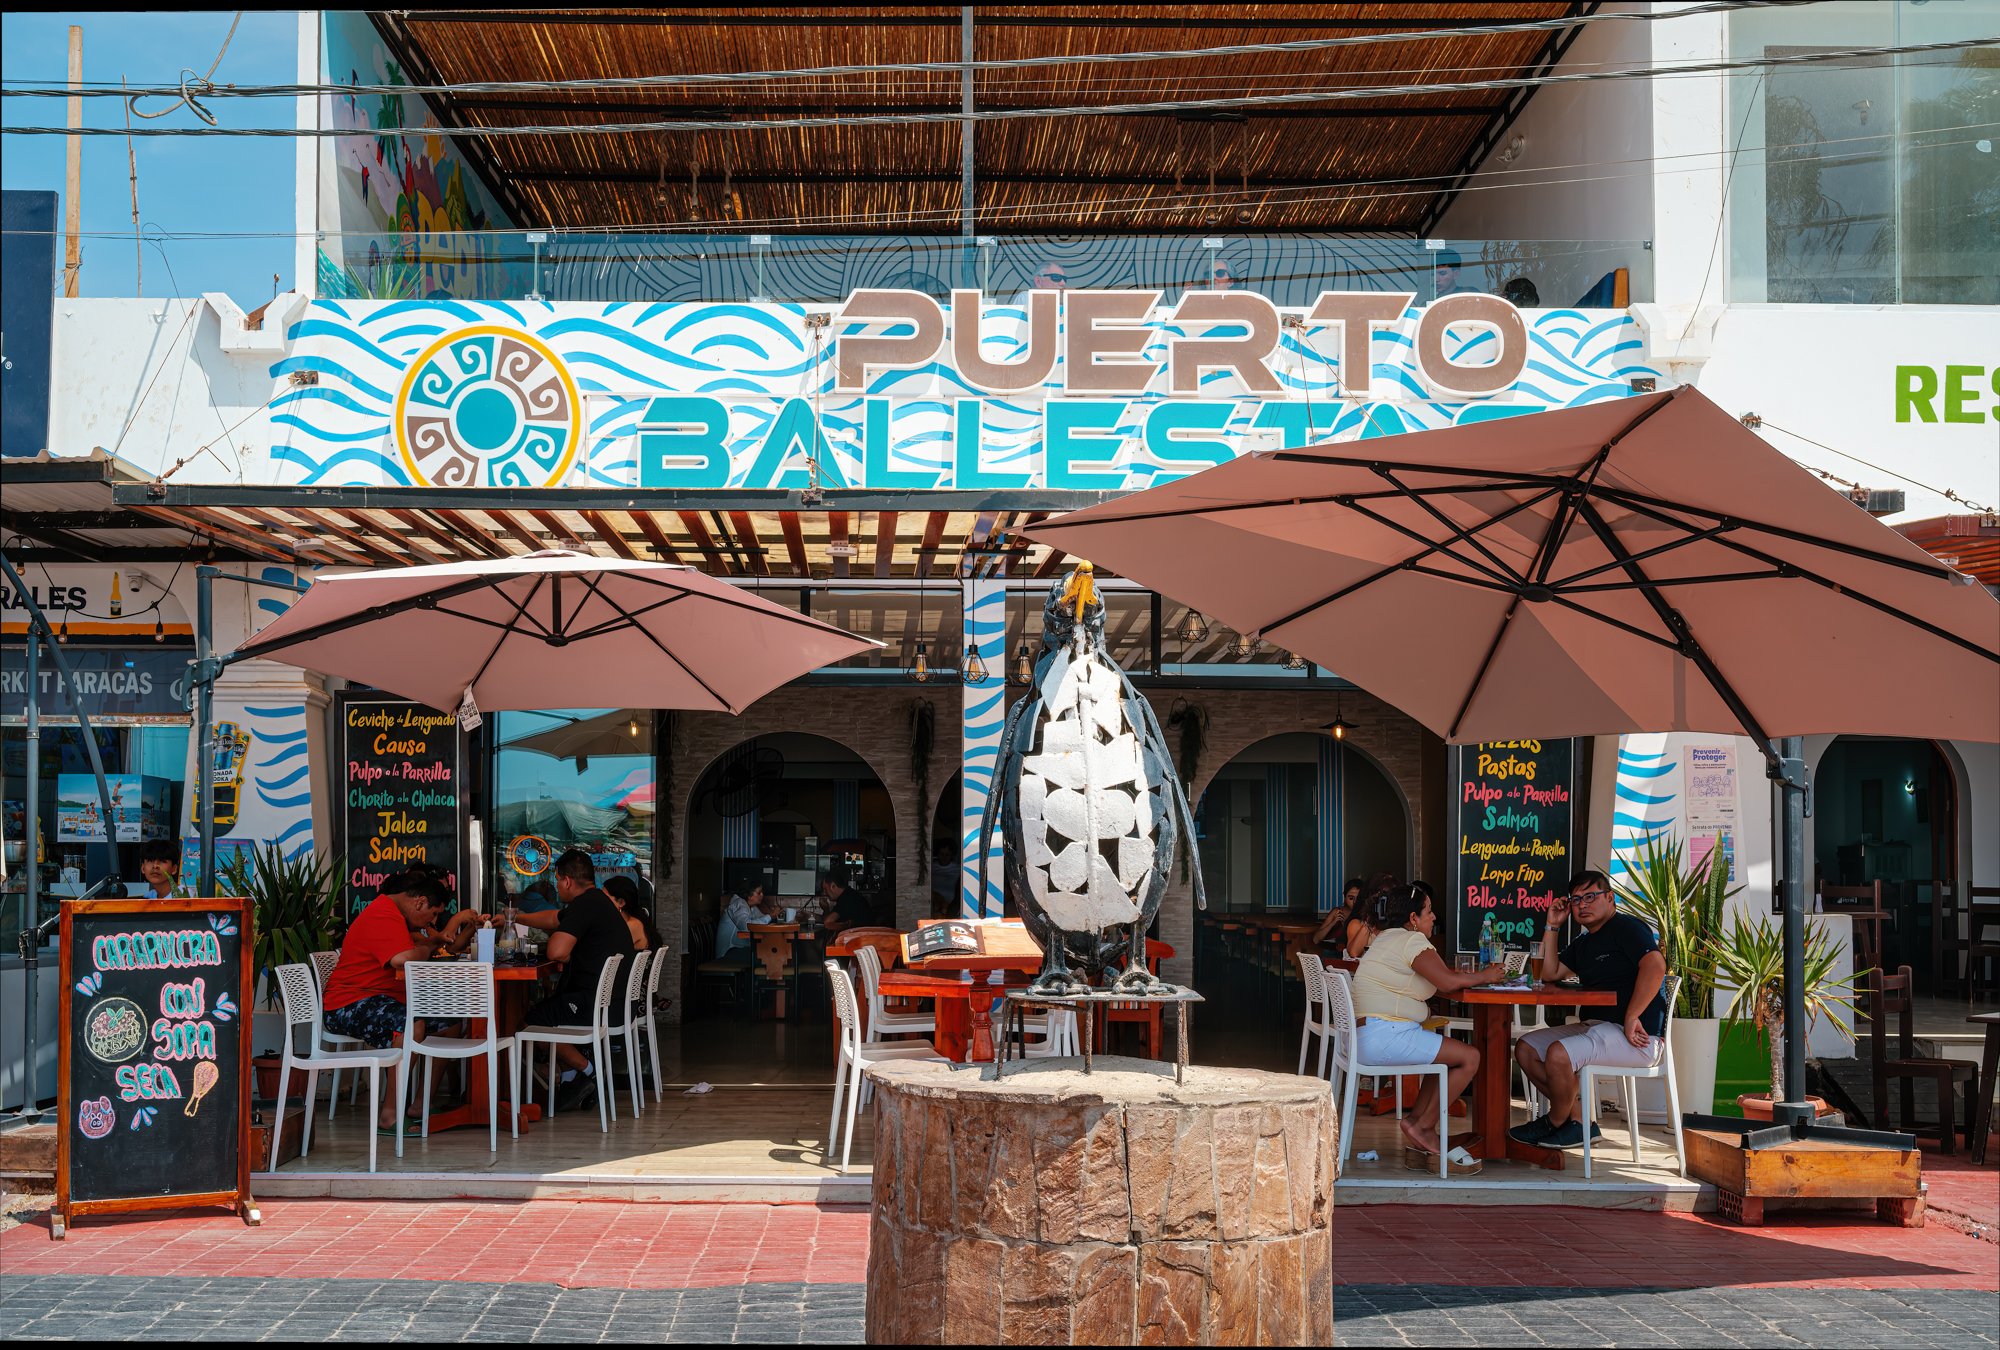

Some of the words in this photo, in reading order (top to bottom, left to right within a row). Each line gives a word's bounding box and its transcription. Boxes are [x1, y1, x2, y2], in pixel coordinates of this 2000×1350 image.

[834, 287, 1529, 397] PUERTO
[1895, 364, 1999, 425] RE
[637, 392, 1547, 490] BALLEST
[1, 671, 52, 693] RKT
[348, 708, 395, 732] Ceviche
[402, 708, 456, 736] Lenguado
[373, 733, 427, 757] Causa
[1692, 754, 1727, 763] Proteger
[348, 760, 383, 786] Pulpo
[392, 763, 399, 777] la
[1478, 753, 1537, 780] Pastas
[411, 788, 456, 812] Chalaca
[1463, 781, 1503, 807] Pulpo
[1513, 786, 1521, 798] la
[377, 810, 427, 838] Jalea
[1482, 805, 1539, 833] Salmón
[368, 836, 427, 865] Salmón
[1460, 835, 1521, 861] Lenguado
[1479, 863, 1515, 888] Lomo
[1516, 863, 1545, 888] Fino
[1467, 885, 1497, 909] Pollo
[92, 929, 222, 971] CARAPULCRA
[159, 976, 206, 1020] CON
[151, 1017, 217, 1061] SOPA
[115, 1061, 182, 1102] SECA
